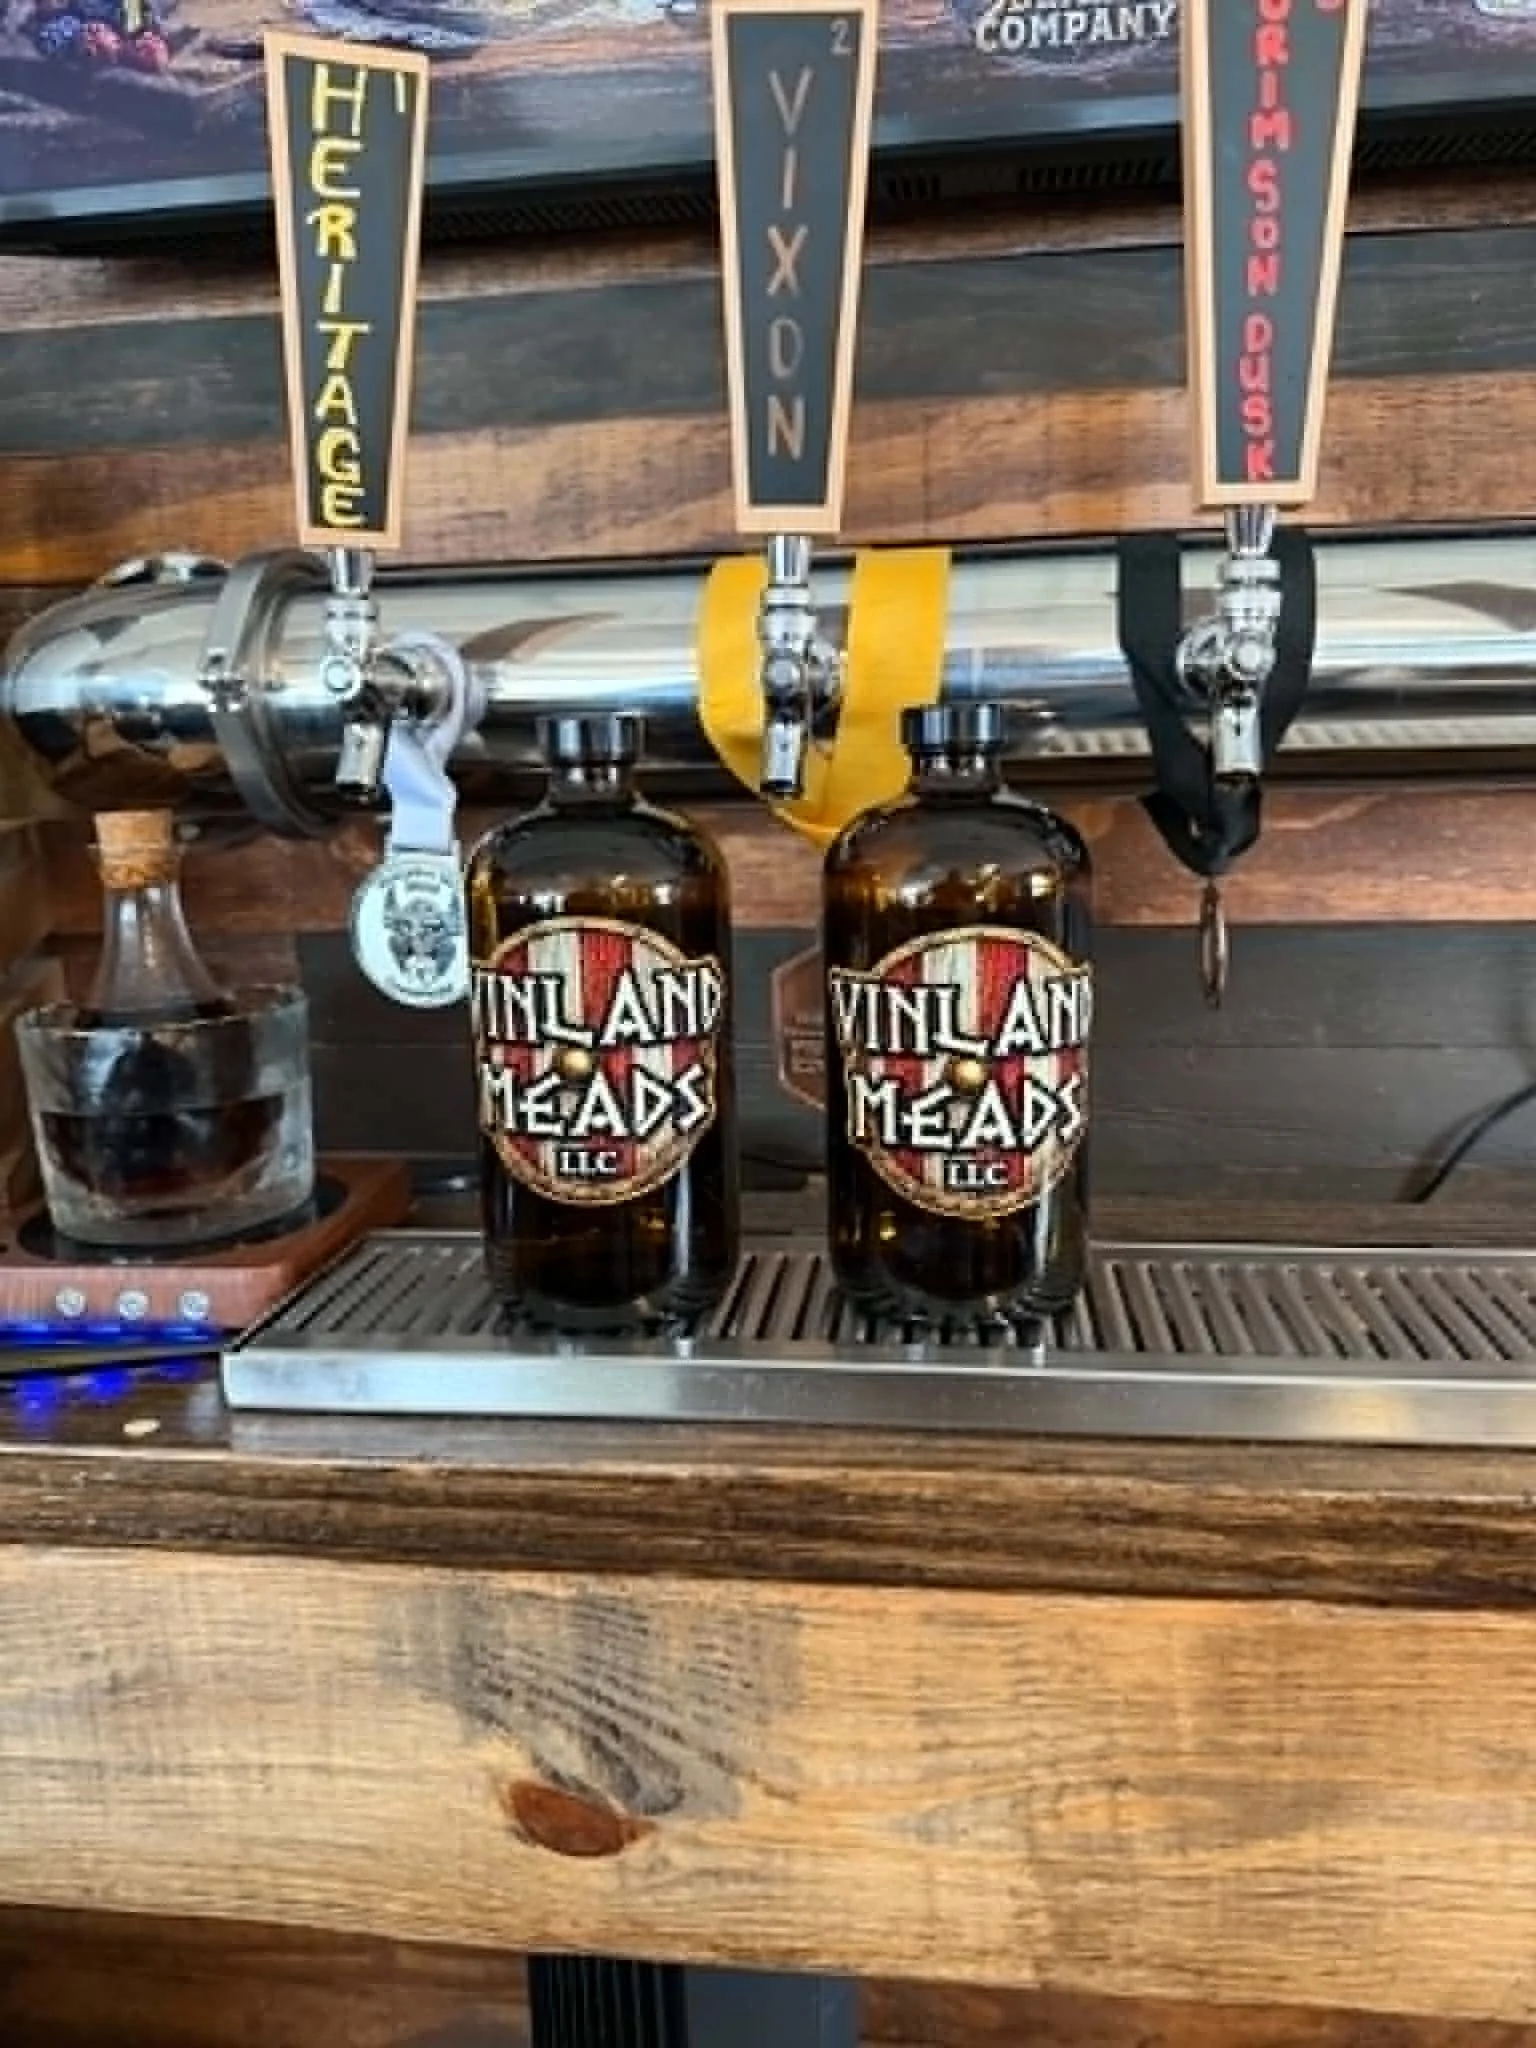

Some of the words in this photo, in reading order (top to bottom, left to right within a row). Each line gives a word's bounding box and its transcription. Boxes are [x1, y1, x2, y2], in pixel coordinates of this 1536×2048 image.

[829, 19, 852, 56] 2
[975, 2, 1177, 50] COMPANY
[306, 63, 370, 526] HERITAGE
[766, 66, 814, 460] VIXON
[1238, 312, 1275, 483] DUSK
[480, 1062, 708, 1137] MEADS
[848, 1073, 1084, 1148] MEADS
[559, 1150, 617, 1174] LLC
